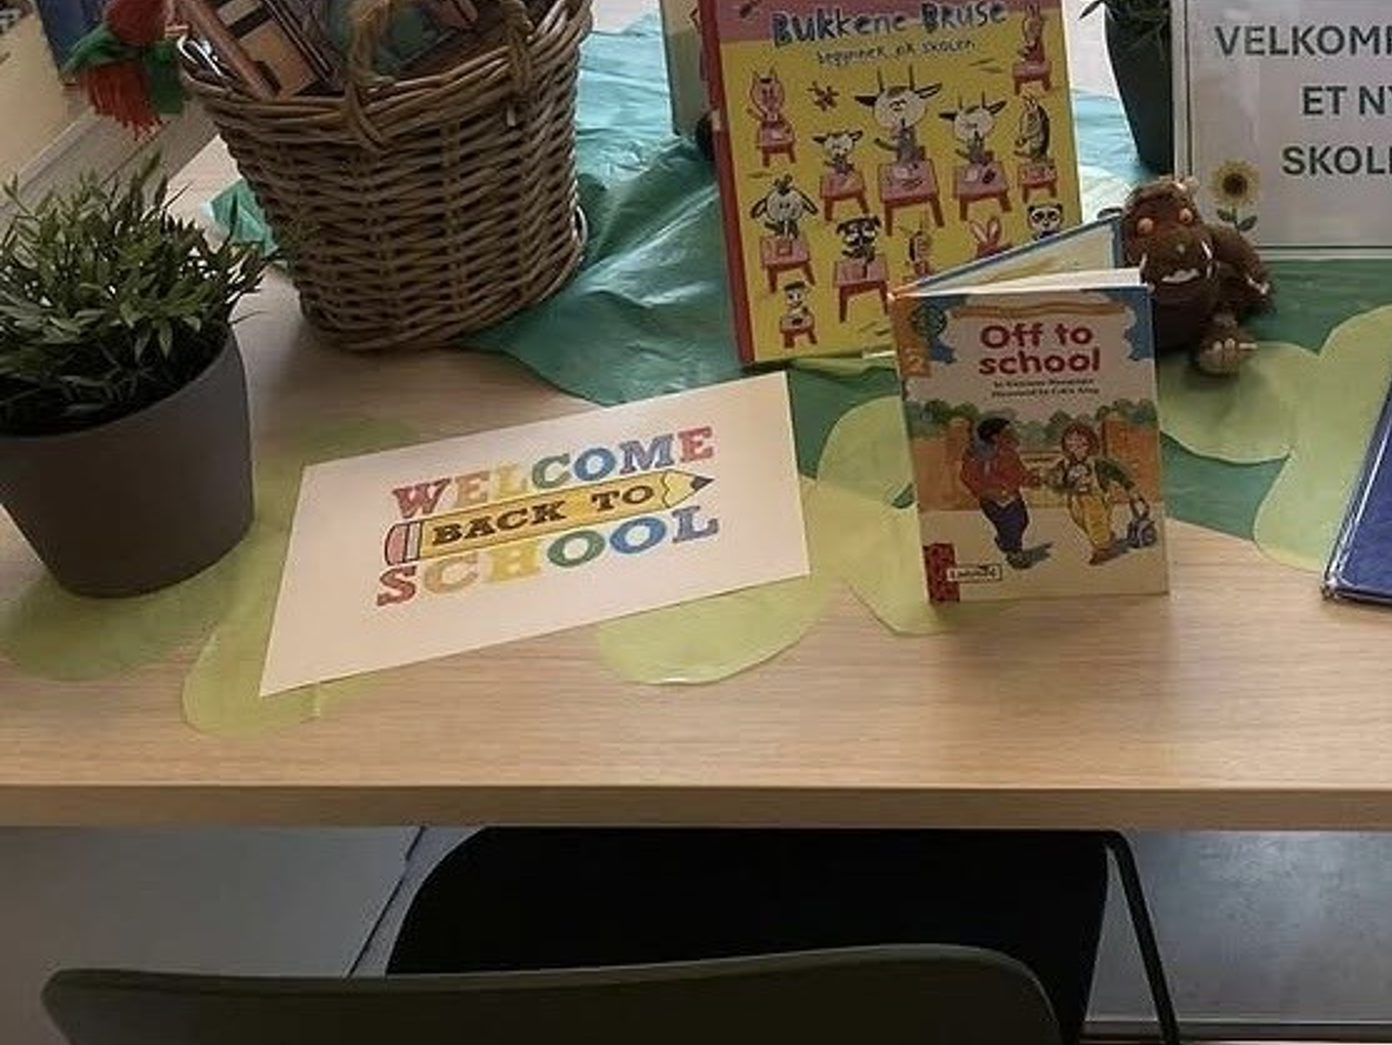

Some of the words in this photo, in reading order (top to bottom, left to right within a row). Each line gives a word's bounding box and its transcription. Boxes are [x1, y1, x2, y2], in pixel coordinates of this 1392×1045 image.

[1302, 86, 1347, 116] ET
[980, 323, 1043, 349] Off
[1054, 322, 1094, 346] to
[979, 349, 1101, 376] school
[391, 425, 714, 519] WELCOME
[432, 498, 568, 547] BACK
[590, 484, 656, 513] TO
[376, 504, 721, 607] SCHOOL
